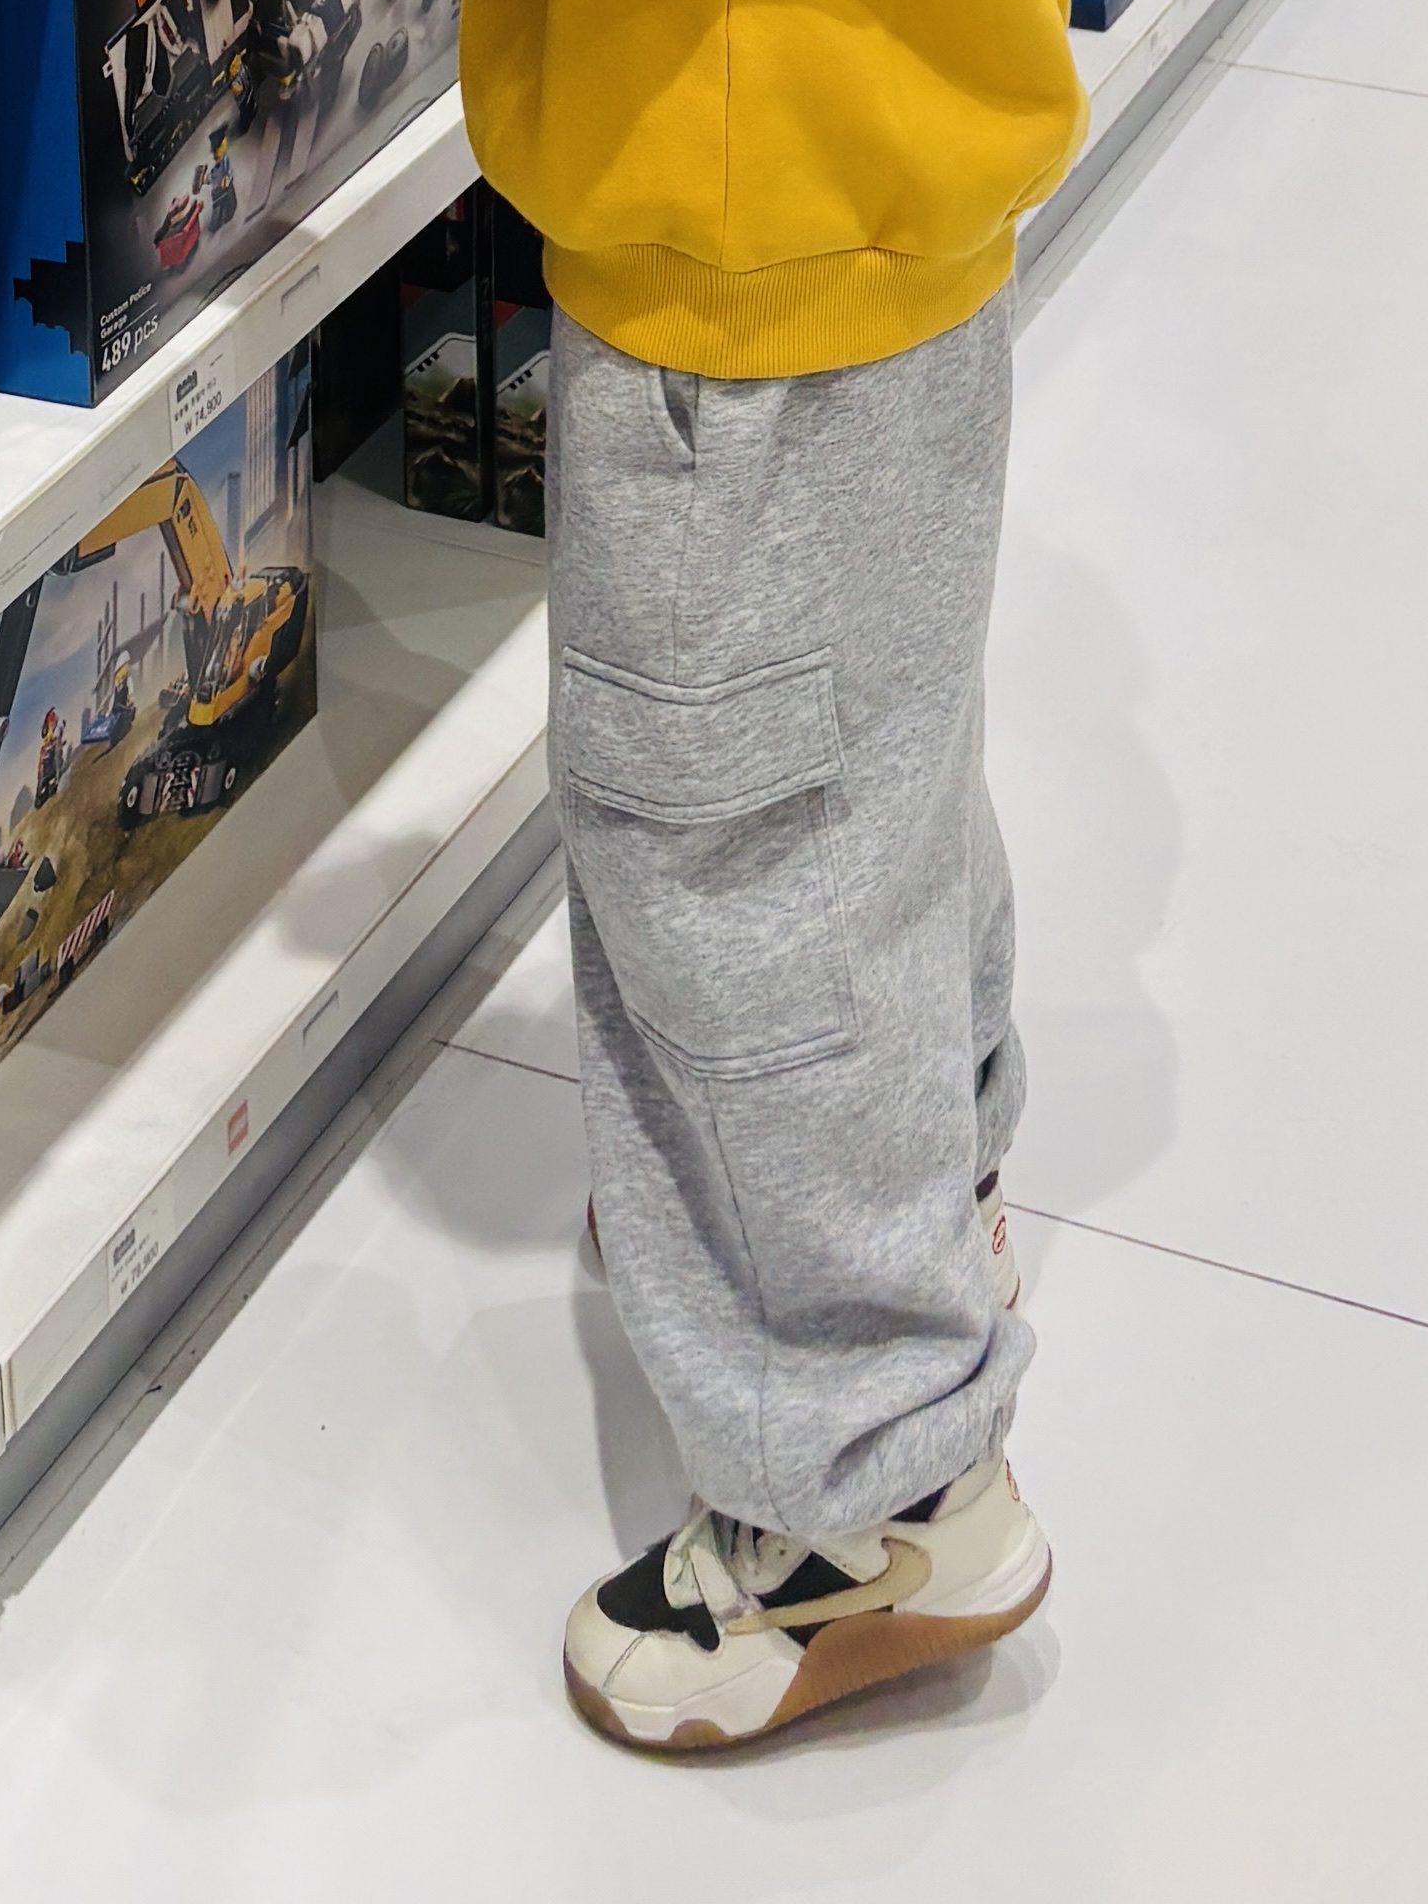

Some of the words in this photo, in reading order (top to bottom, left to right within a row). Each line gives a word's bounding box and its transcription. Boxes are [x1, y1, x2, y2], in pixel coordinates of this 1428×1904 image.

[99, 302, 128, 329] Custom
[99, 327, 132, 374] 489
[132, 312, 160, 356] pcs
